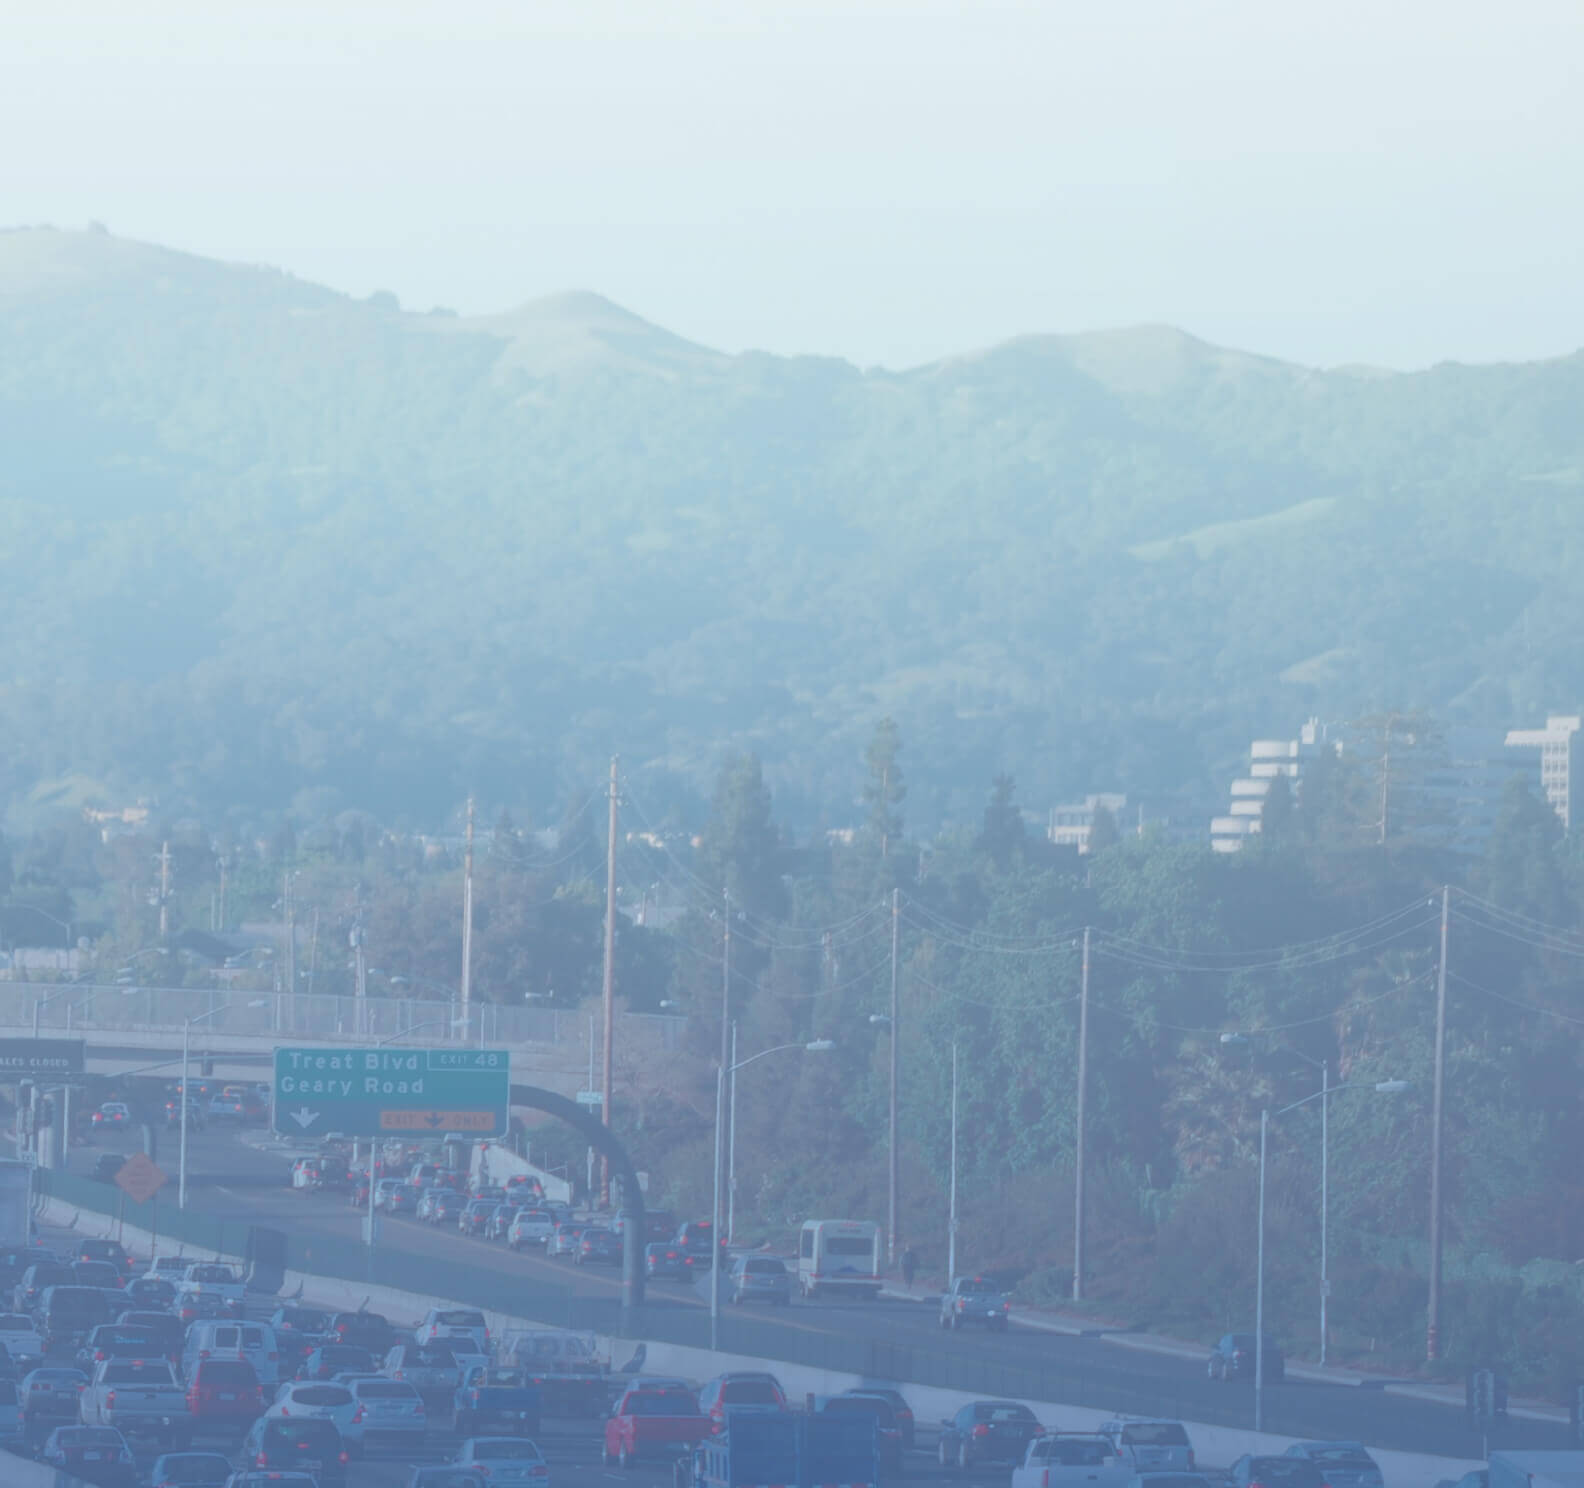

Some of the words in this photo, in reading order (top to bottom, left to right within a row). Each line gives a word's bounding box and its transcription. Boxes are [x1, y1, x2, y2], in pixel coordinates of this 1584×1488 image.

[29, 1057, 70, 1067] CLOSED
[288, 1052, 353, 1069] Treat
[365, 1053, 418, 1070] Blvd
[440, 1054, 468, 1065] EXIT
[474, 1054, 499, 1067] 48
[280, 1076, 353, 1096] Geary
[364, 1076, 424, 1094] Road
[382, 1113, 417, 1126] EXIT
[452, 1113, 489, 1127] ONLY
